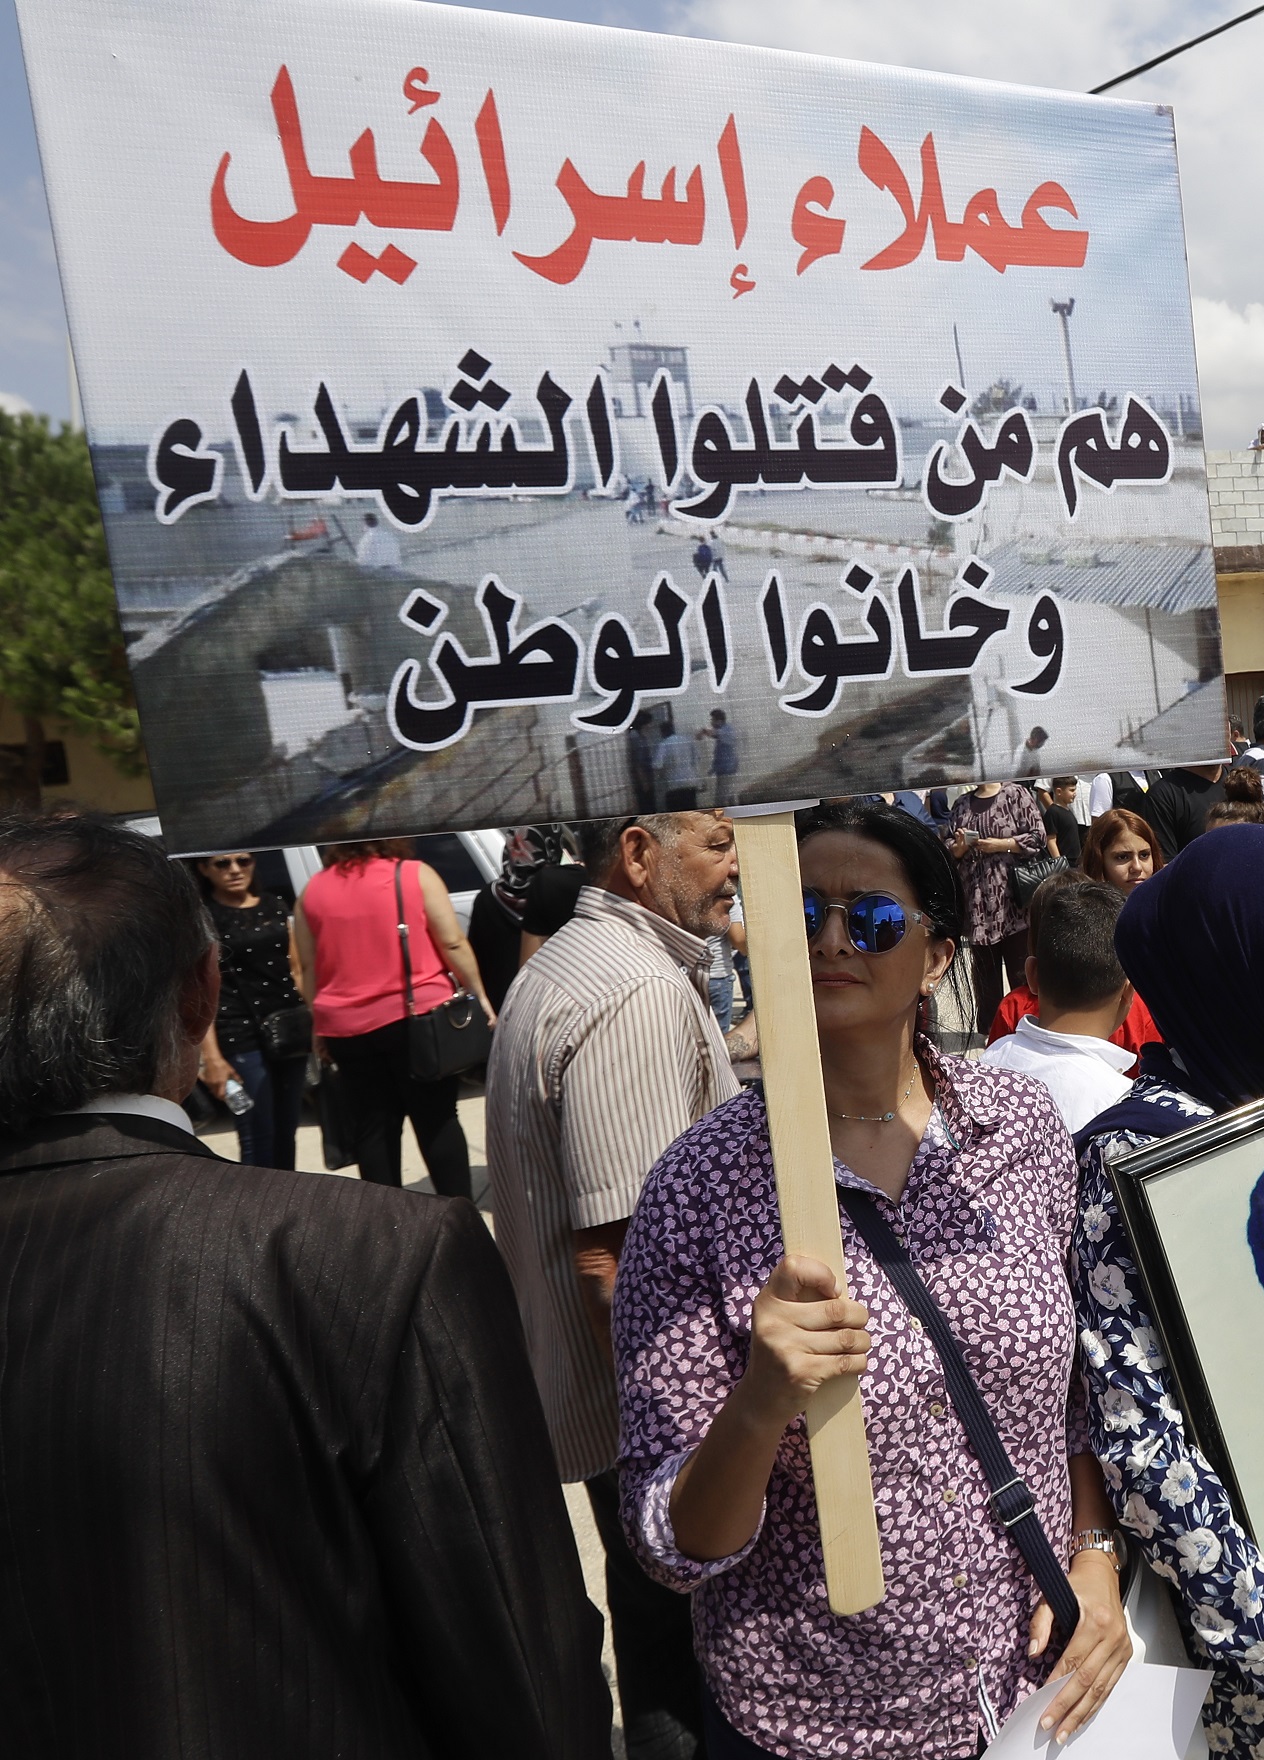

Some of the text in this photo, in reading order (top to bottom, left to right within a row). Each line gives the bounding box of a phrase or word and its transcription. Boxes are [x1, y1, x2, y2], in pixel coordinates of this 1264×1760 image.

[211, 65, 1089, 298] عملاء إسرائيل
[155, 348, 1170, 526] هم من قتلوا الشهداء
[394, 561, 1065, 746] وخانوا الوطن
